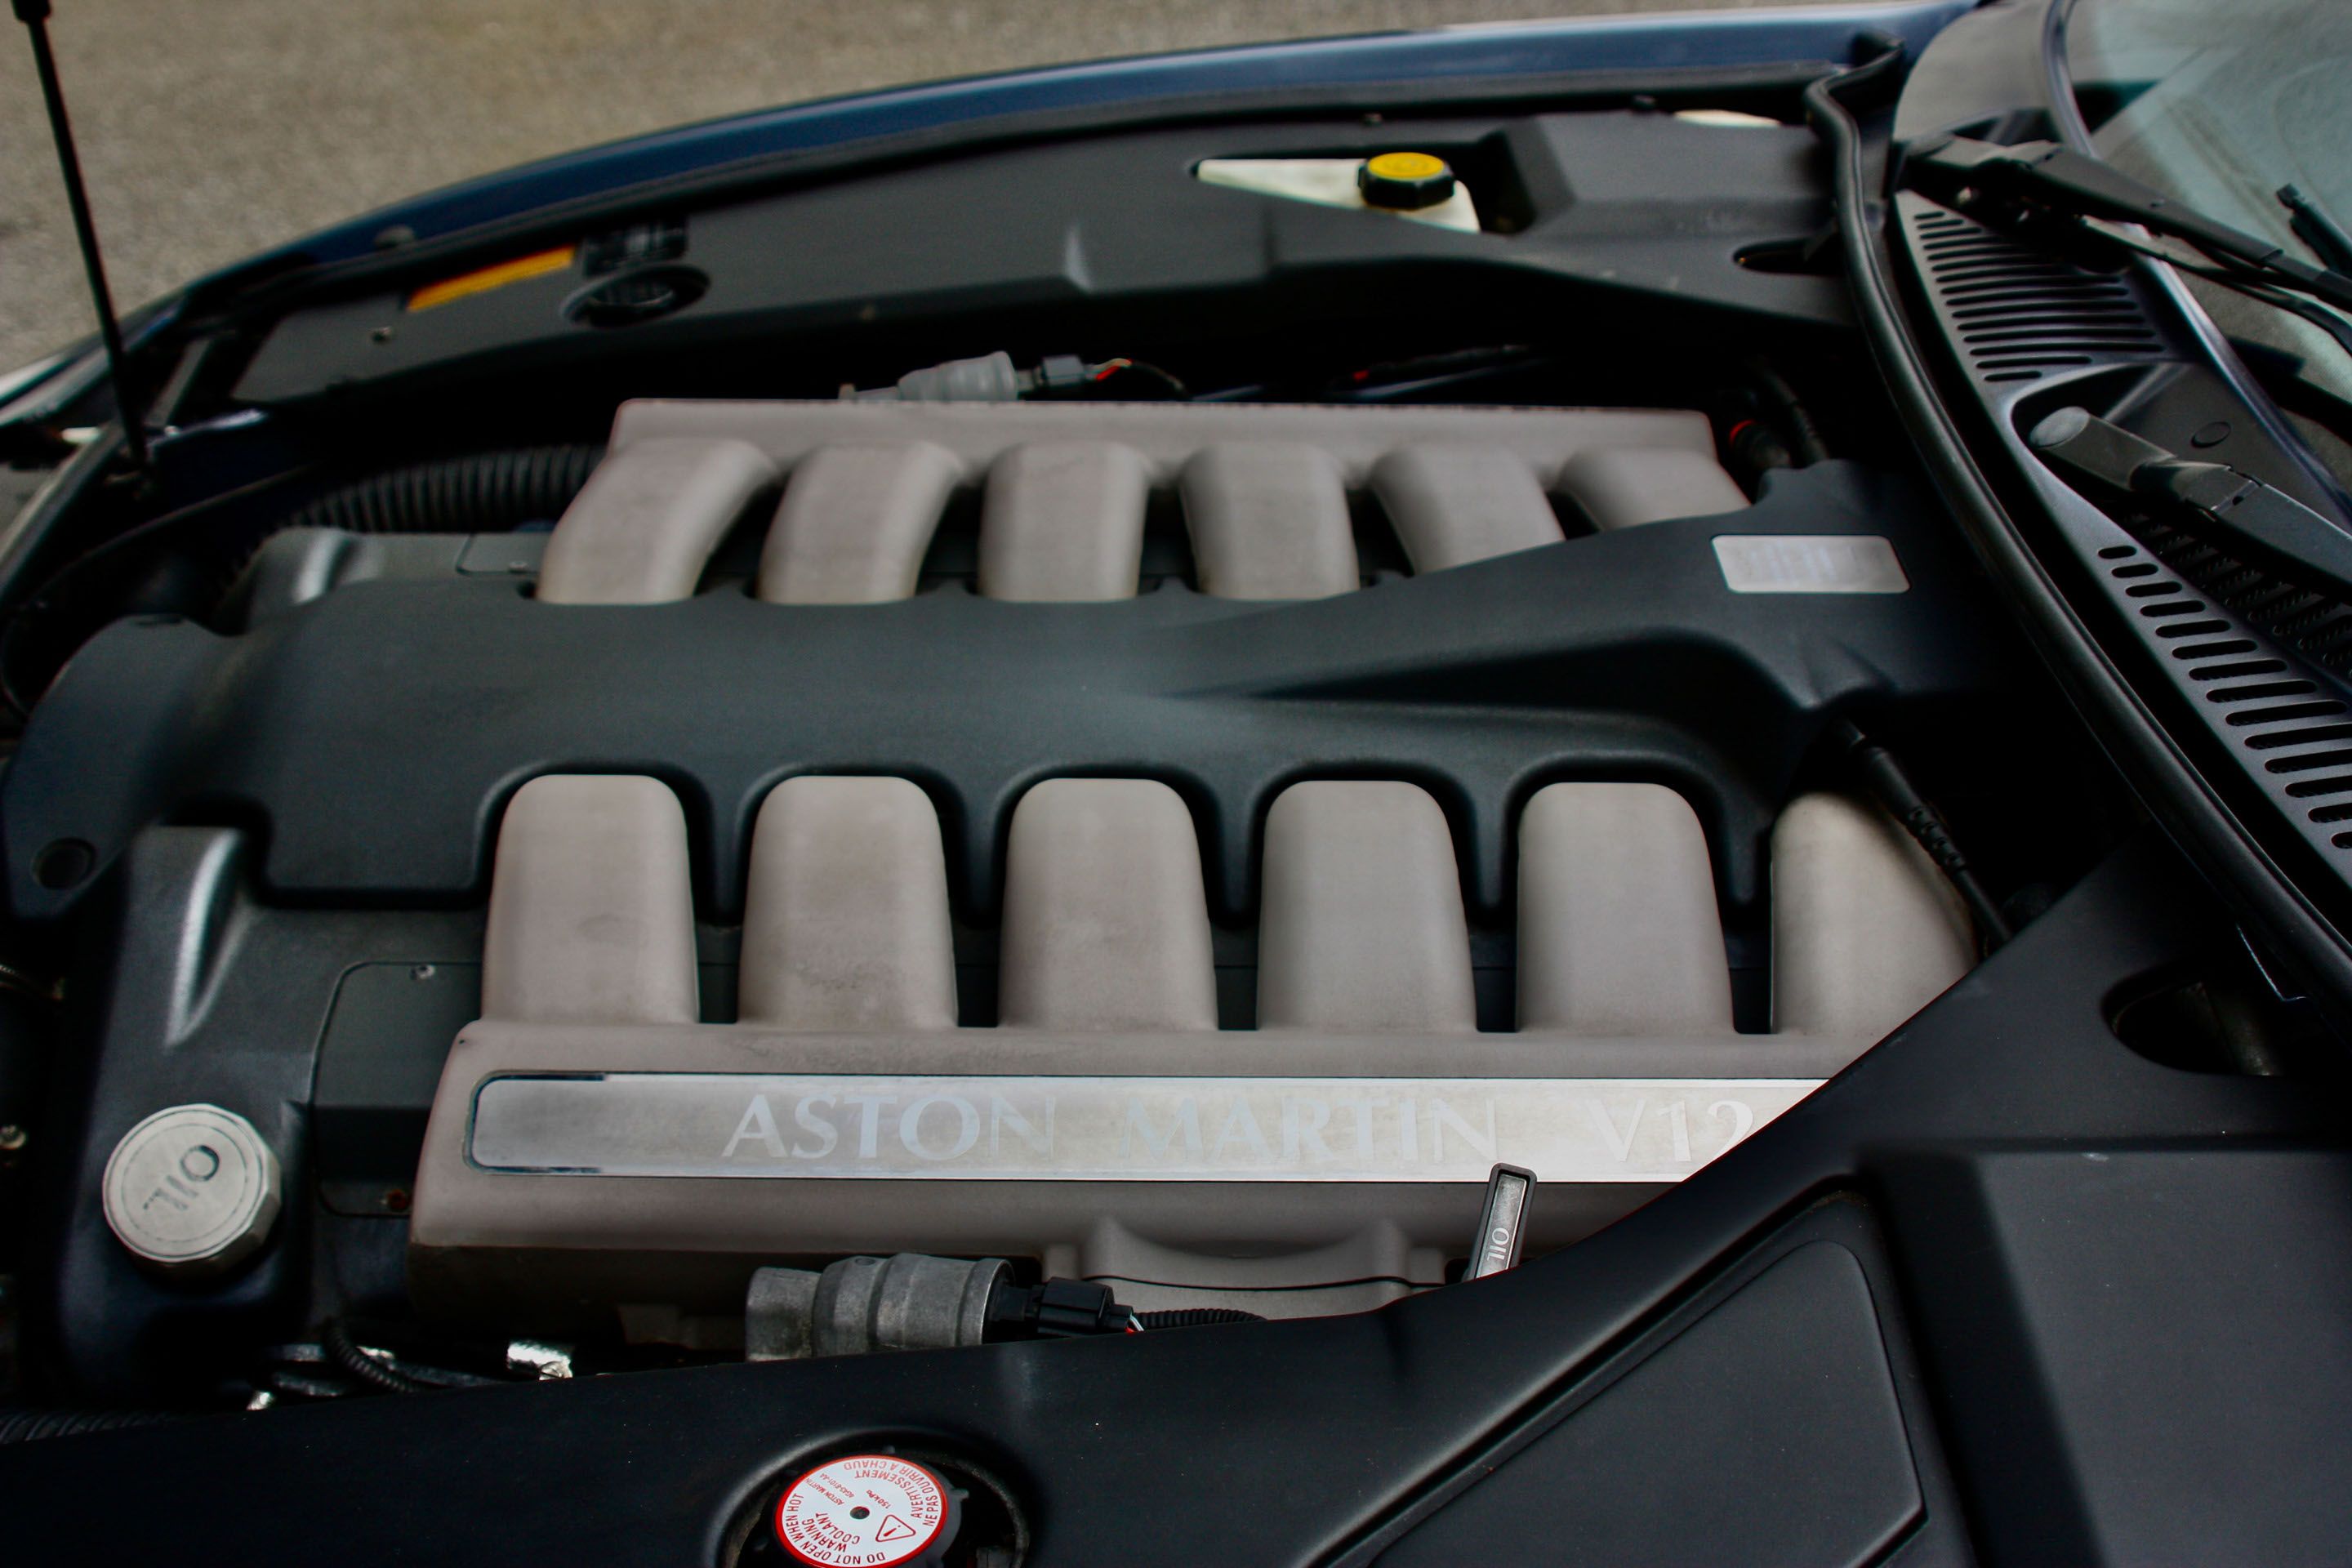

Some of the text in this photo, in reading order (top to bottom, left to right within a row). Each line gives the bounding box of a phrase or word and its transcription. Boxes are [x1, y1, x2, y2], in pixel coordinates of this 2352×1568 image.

[722, 1093, 1753, 1163] ASTON MARTIN V12
[141, 1145, 220, 1210] OIL
[1486, 1227, 1510, 1261] OIL
[844, 1460, 887, 1470] CHAUD
[899, 1466, 934, 1494] OUVRIR
[804, 1477, 844, 1506] ASTON MARTIN
[855, 1469, 923, 1519] AVERTISSEMENT
[925, 1495, 938, 1514] PAS
[786, 1493, 886, 1564] DO NOT OPEN WHEN HOT
[802, 1518, 847, 1552] WARNING
[816, 1512, 861, 1545] COOLANT
[922, 1515, 938, 1527] NE
